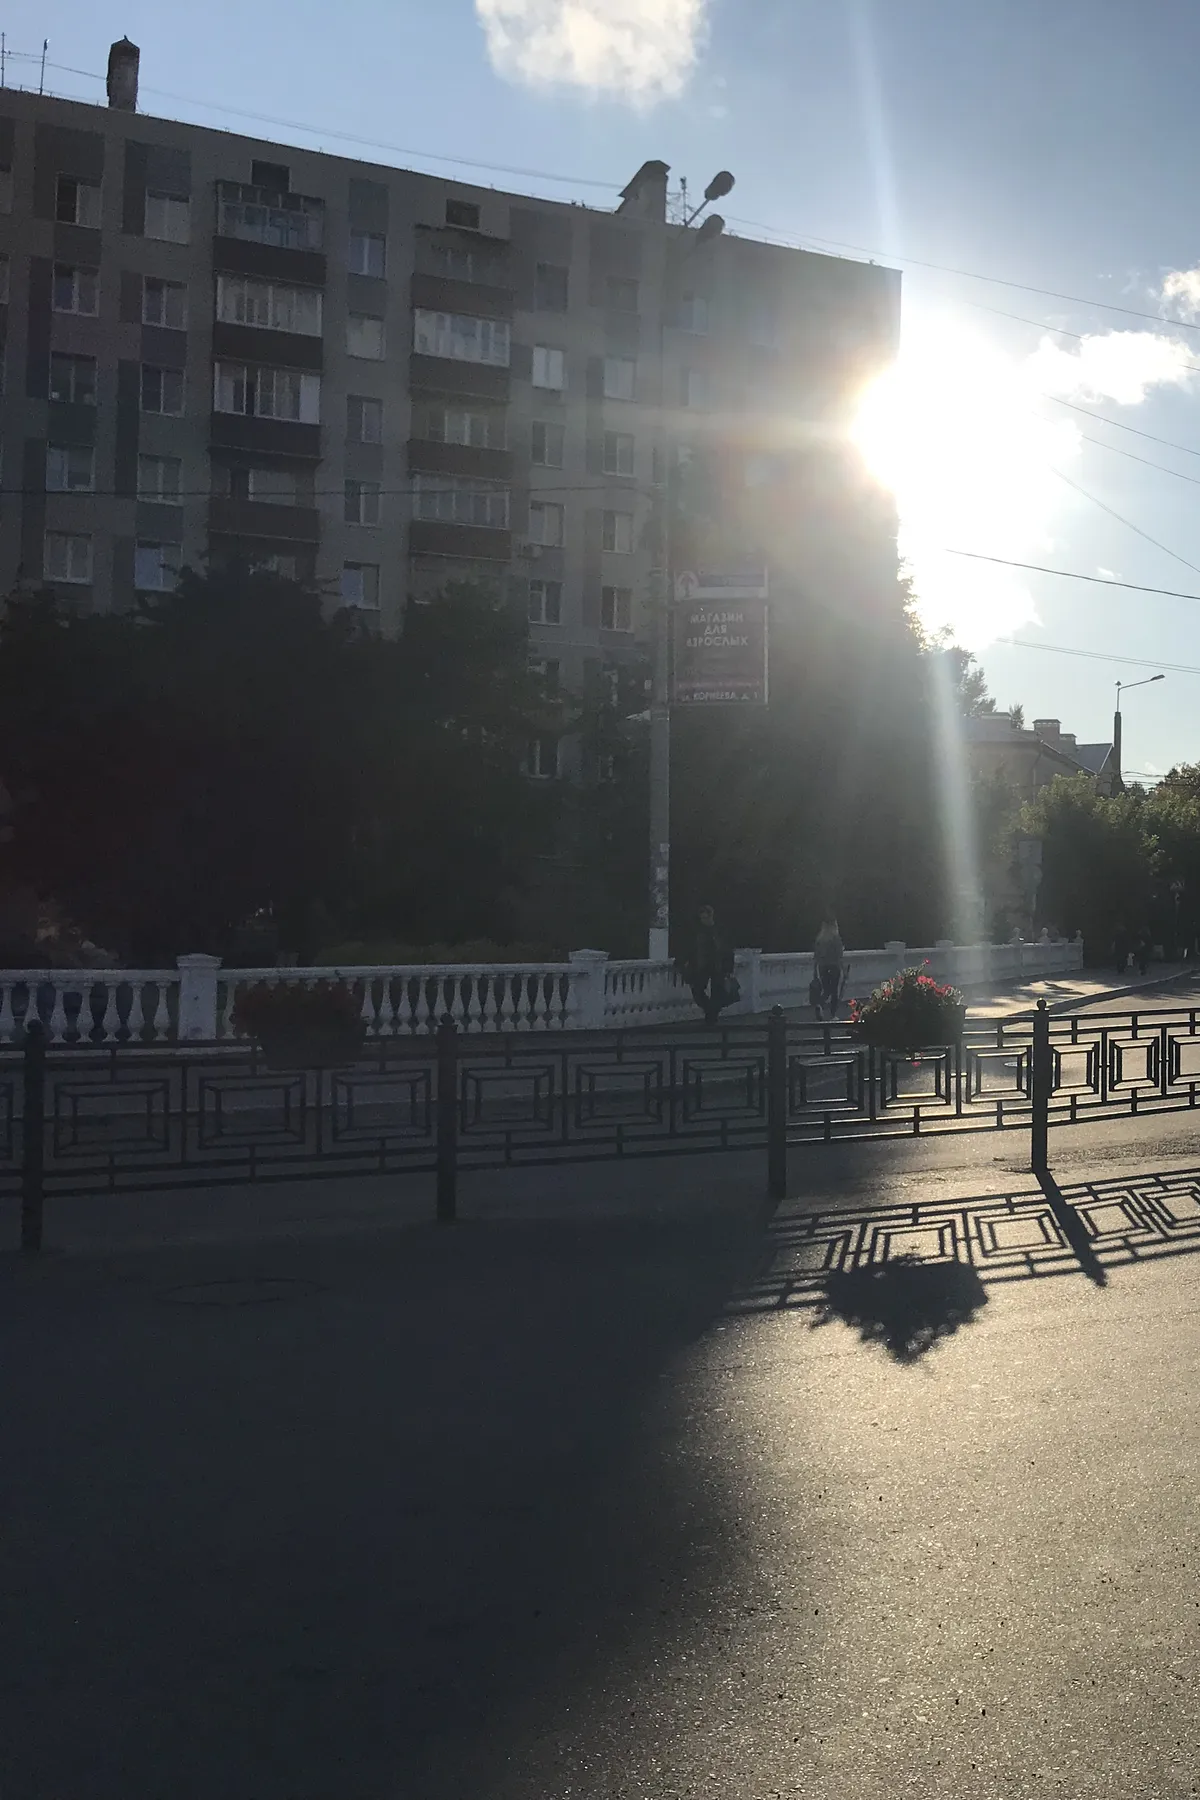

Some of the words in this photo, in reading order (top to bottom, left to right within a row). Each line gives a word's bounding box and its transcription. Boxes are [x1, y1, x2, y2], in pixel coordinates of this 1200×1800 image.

[690, 612, 744, 623] МАГАЗИН
[704, 623, 727, 636] ДЛЯ
[686, 635, 749, 647] ВЗРОСЛЫХ
